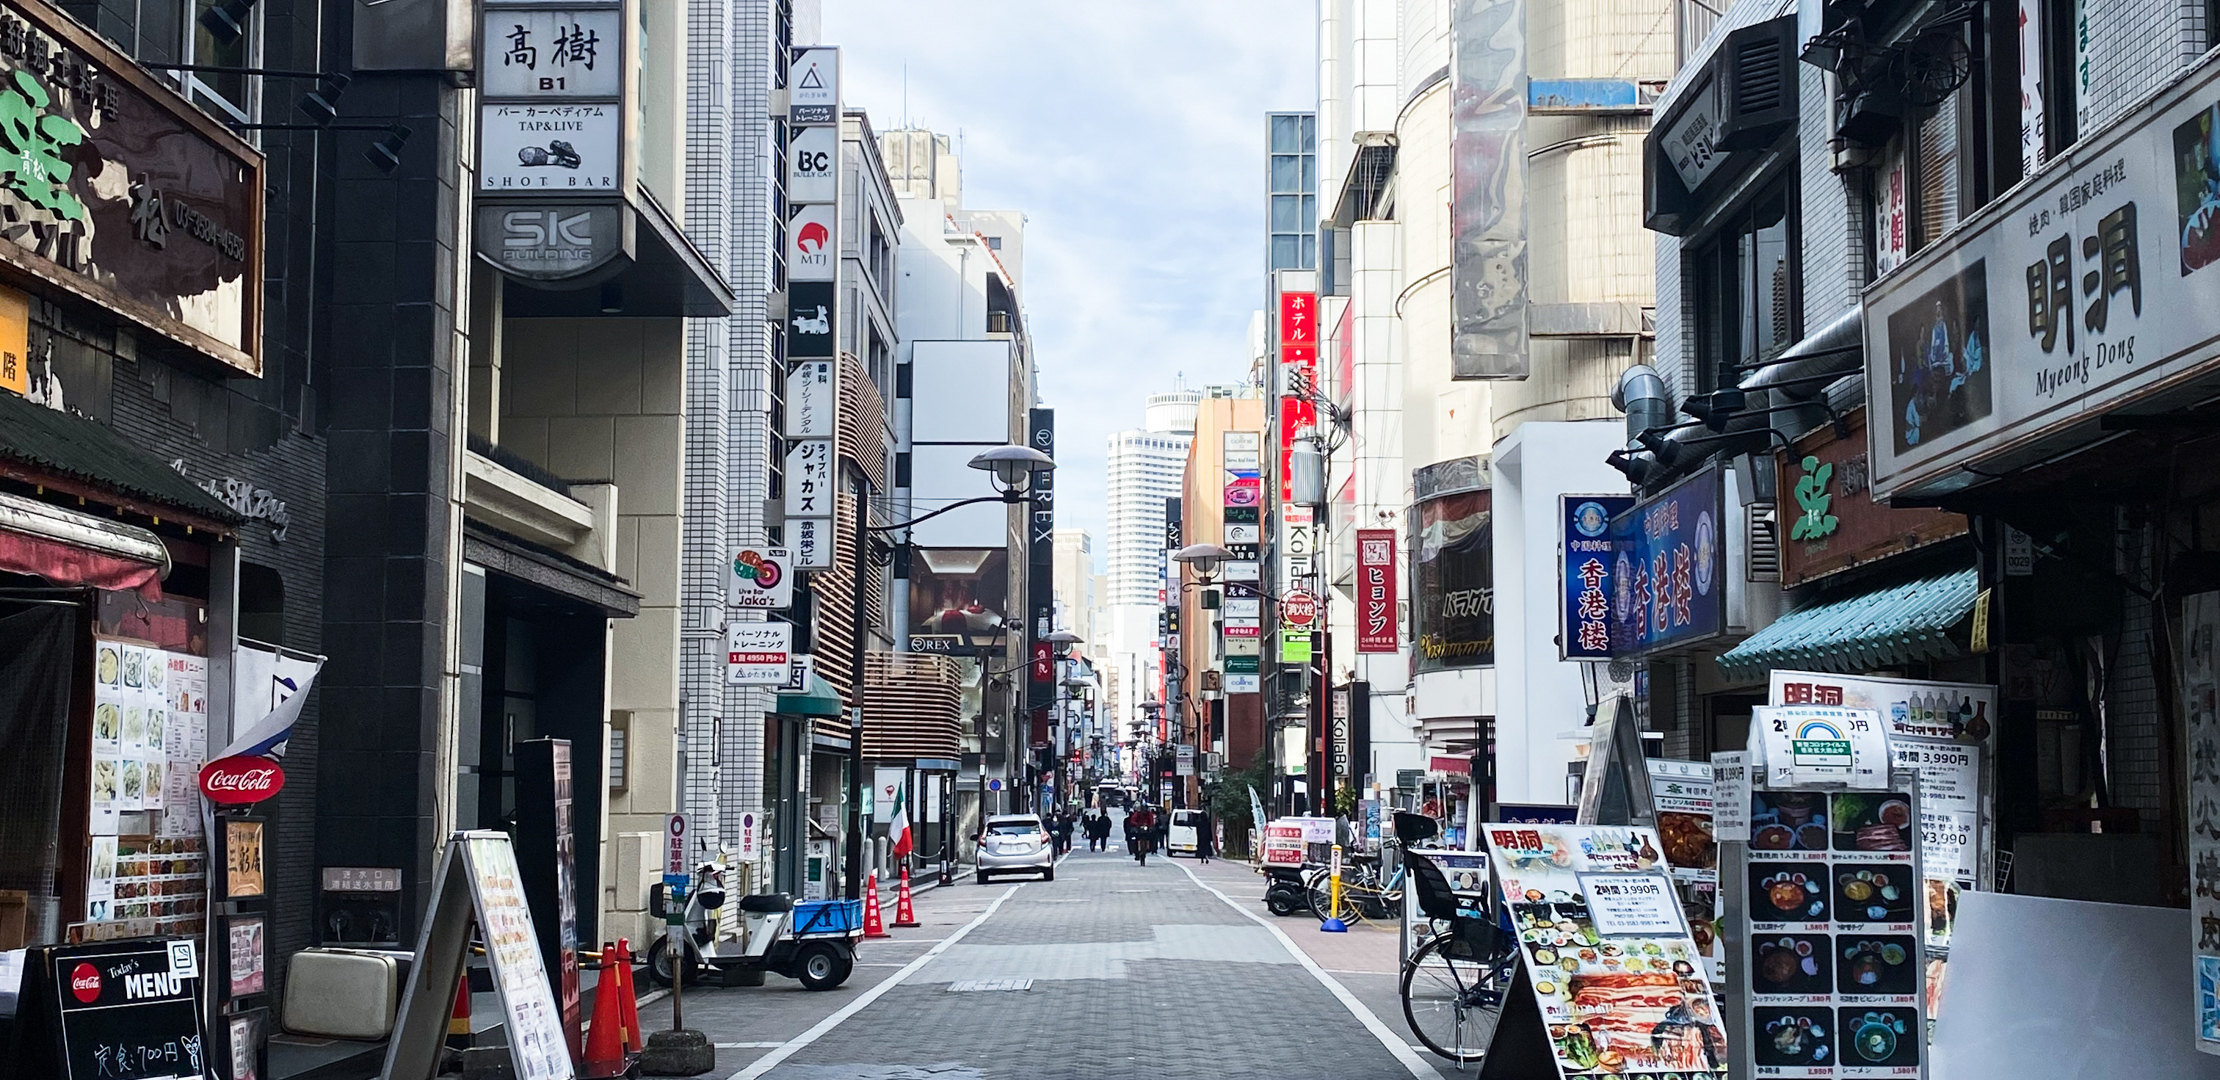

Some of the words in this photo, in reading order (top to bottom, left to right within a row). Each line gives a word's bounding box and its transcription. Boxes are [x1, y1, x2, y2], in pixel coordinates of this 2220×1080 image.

[503, 24, 600, 71] 高樹
[539, 77, 565, 90] B1
[497, 107, 520, 117] バー
[526, 107, 604, 118] カーペディアム
[518, 121, 584, 132] TAP&LIVE
[798, 150, 829, 172] BC
[487, 177, 548, 187] SHOT
[568, 177, 611, 187] BAR
[2028, 158, 2127, 238] 焼肉・韓国家庭料理
[503, 211, 592, 247] SK
[503, 249, 592, 260] BUILDING
[801, 254, 827, 266] MTJ
[2035, 356, 2090, 399] Myeong
[2096, 334, 2136, 371] Dong
[817, 443, 827, 487] ライブバー
[801, 444, 815, 512] ジャカズ
[1034, 488, 1054, 544] REX
[800, 520, 815, 566] 赤坂栄ビル
[1570, 540, 1613, 553] 中国料理
[2008, 556, 2030, 567] 0029
[1632, 542, 1693, 641] 香港楼
[738, 596, 776, 606] Jaka'z
[1286, 603, 1314, 616] 消火栓
[1577, 557, 1610, 652] 香港楼
[736, 630, 780, 638] パーソナル
[734, 640, 785, 649] トレーニング
[927, 638, 951, 650] REX
[1333, 717, 1347, 776] KollaBo
[1923, 753, 1968, 766] 3,990円
[206, 769, 276, 791] Coca-Cola
[1490, 829, 1544, 851] 明洞
[1594, 885, 1620, 895] 2時間
[1621, 885, 1660, 895] 3,990円
[106, 958, 140, 979] Today's
[72, 976, 100, 990] Coca-Cola
[124, 970, 183, 1000] MENU
